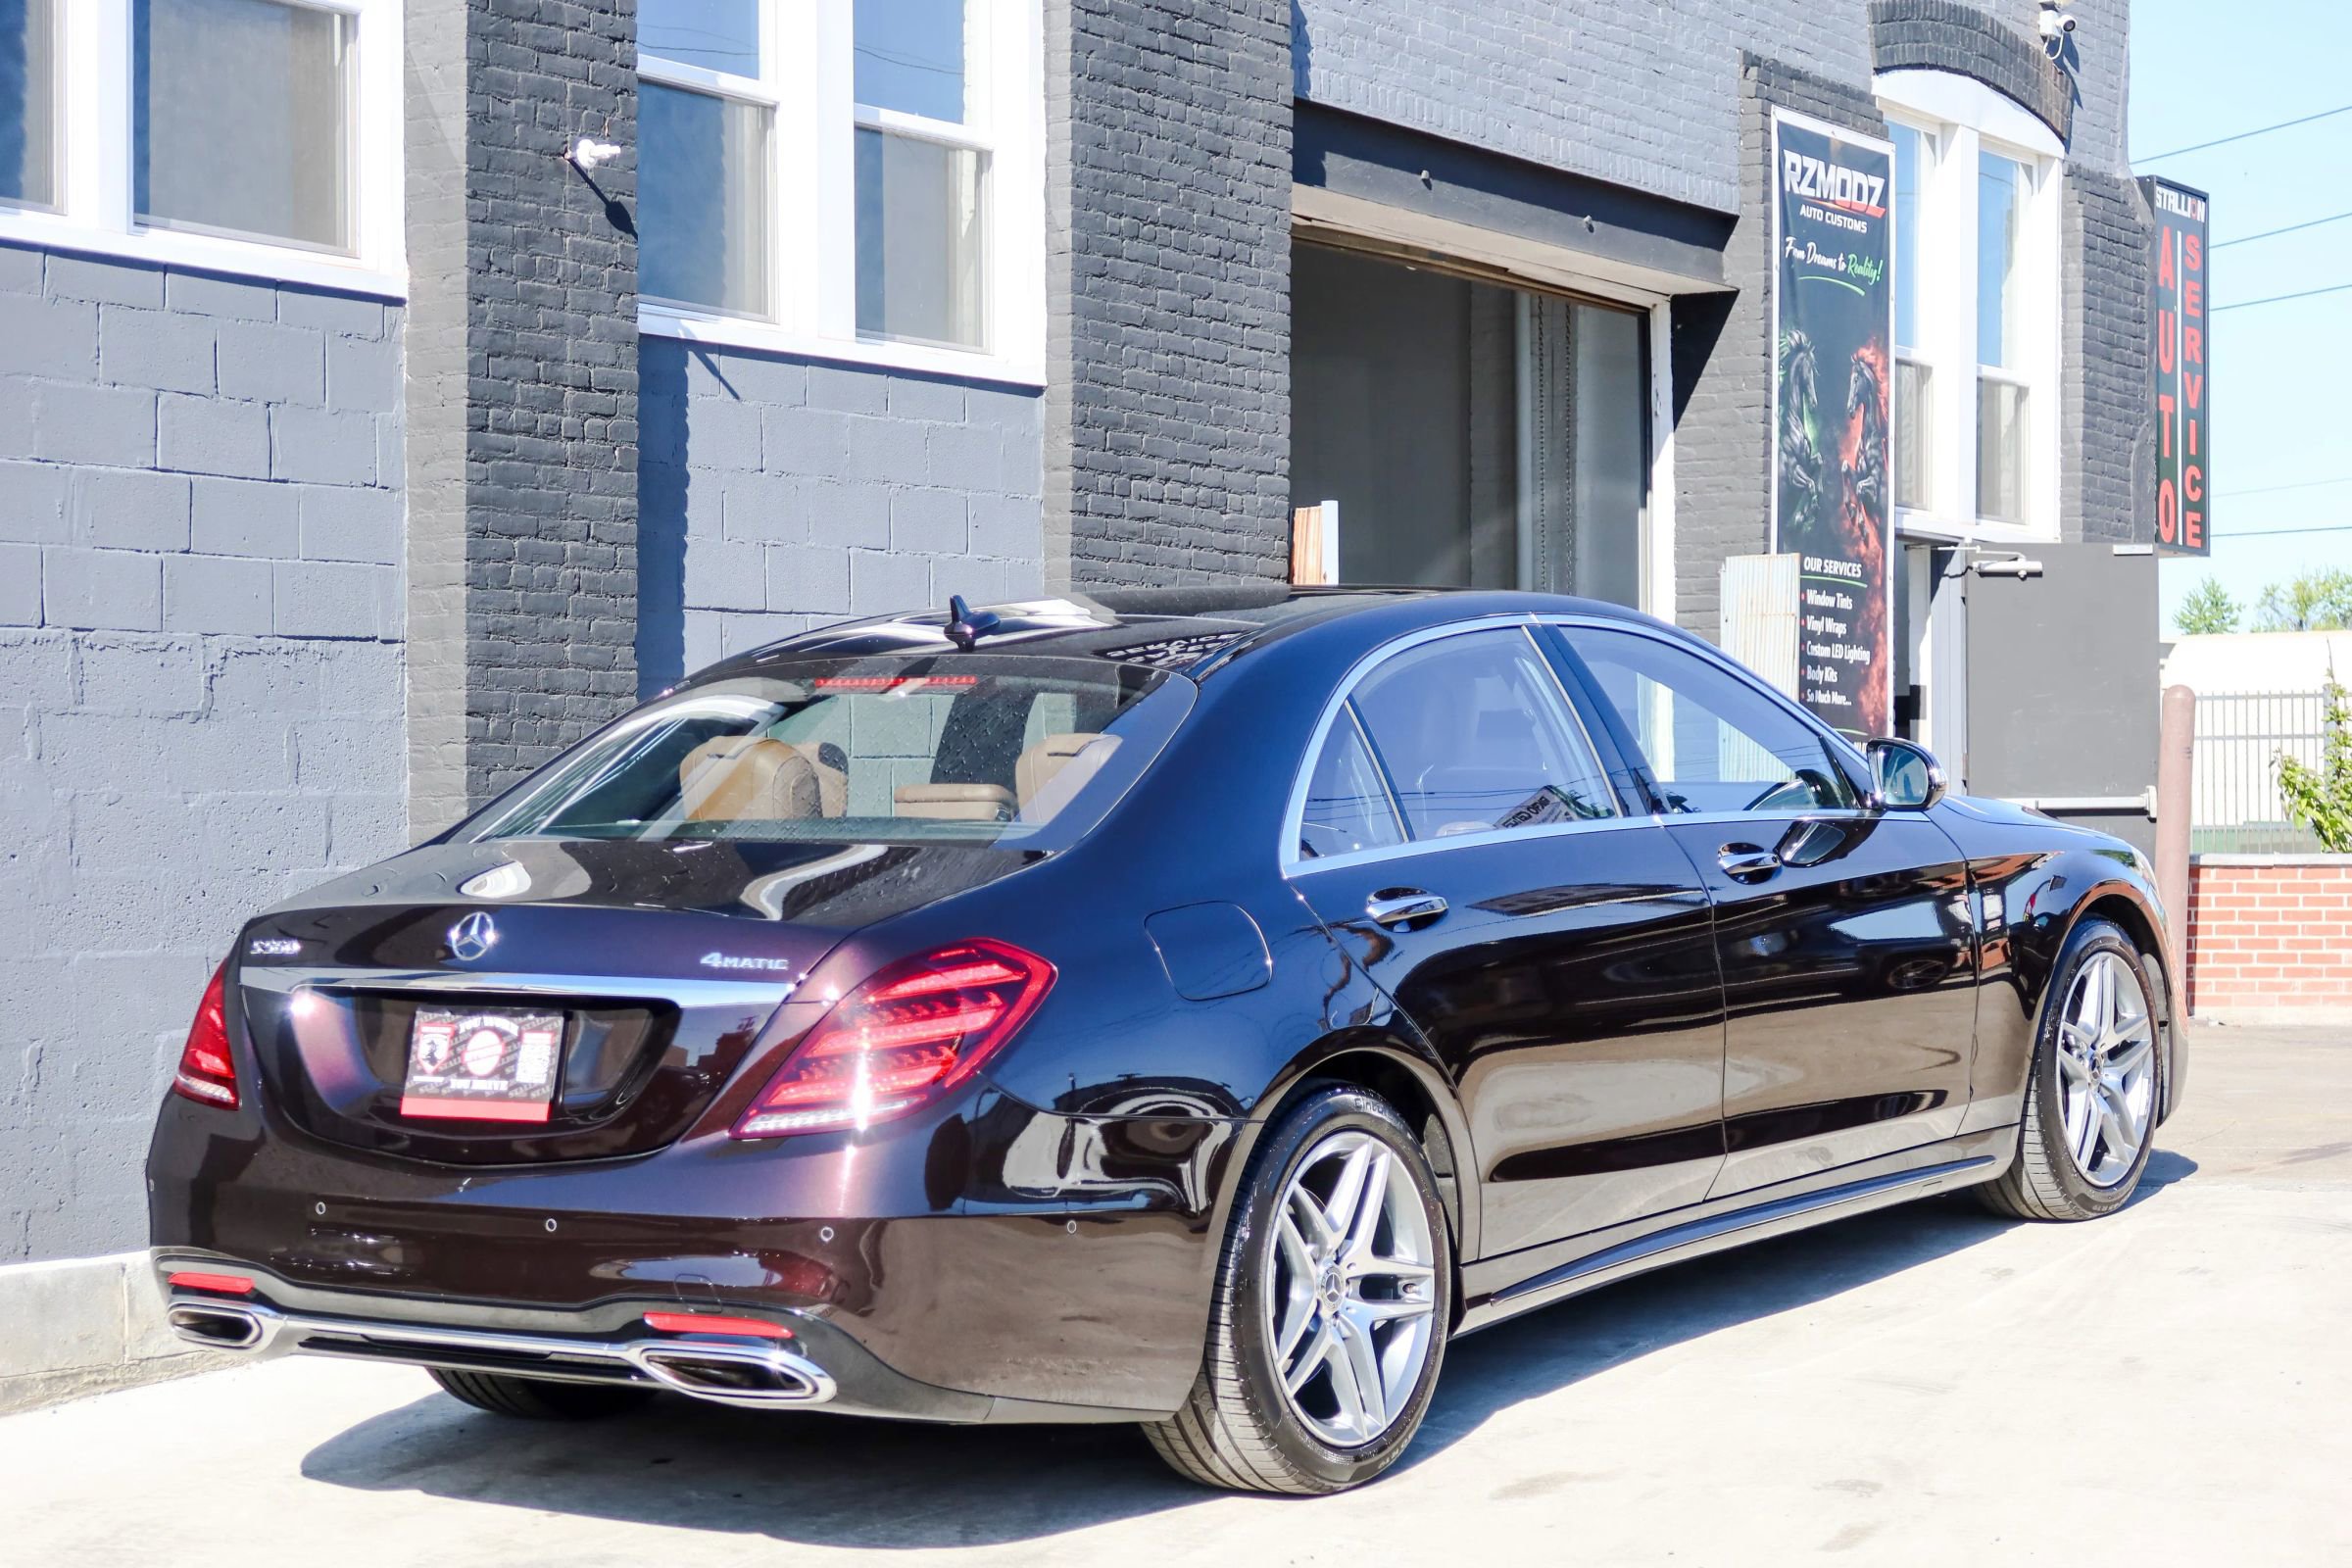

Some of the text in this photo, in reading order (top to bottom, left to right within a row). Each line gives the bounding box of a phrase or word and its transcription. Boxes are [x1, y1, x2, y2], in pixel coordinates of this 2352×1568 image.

[1783, 149, 1886, 218] RZMODZ
[2156, 184, 2205, 222] STALLION
[1799, 204, 1867, 233] AUTO CUSTOMS
[1786, 236, 1884, 286] From Dreams to Reality!
[2158, 225, 2176, 543] AUTO
[2183, 234, 2203, 548] SERVICE
[1804, 557, 1862, 578] OUR SERVICES
[1806, 589, 1853, 610] Window Tints
[1806, 615, 1847, 638] Vinyl Wraps
[1806, 640, 1871, 665] Custom LED Lighting
[1806, 664, 1838, 685] Body Kits
[1806, 688, 1814, 703] So
[1815, 689, 1831, 705] Much
[700, 952, 789, 971] 4MATIC
